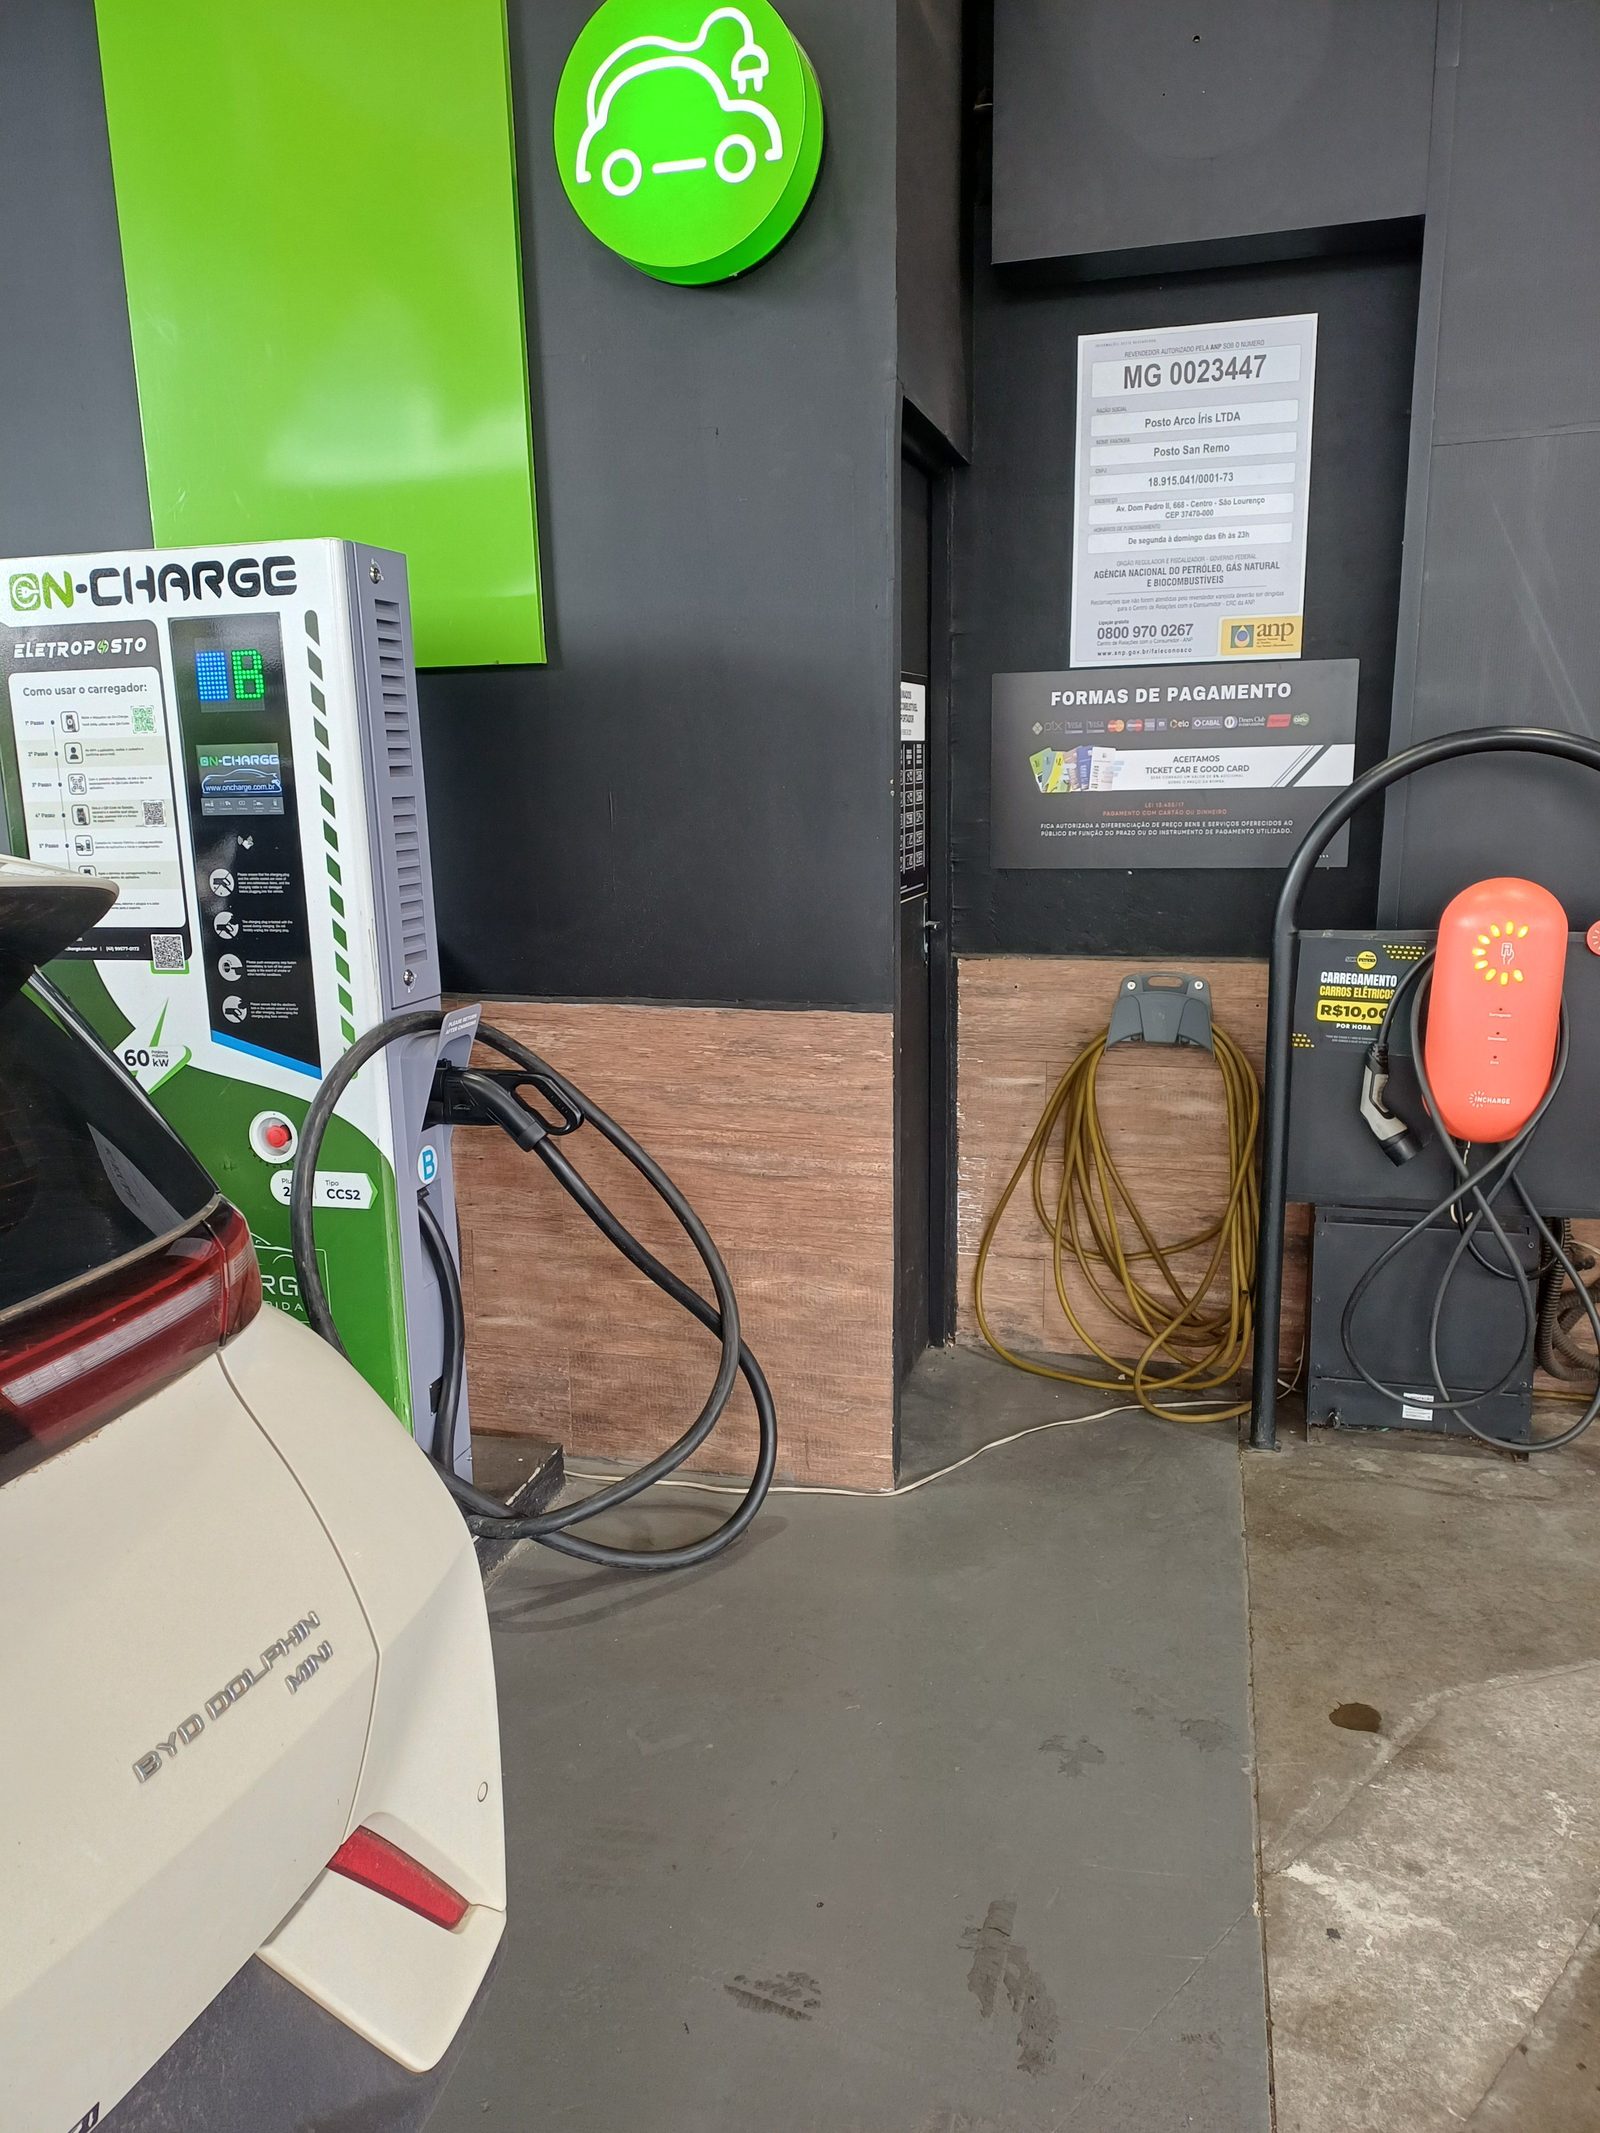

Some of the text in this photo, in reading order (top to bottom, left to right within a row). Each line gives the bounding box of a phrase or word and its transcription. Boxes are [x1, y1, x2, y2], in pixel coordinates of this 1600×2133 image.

[1124, 354, 1267, 389] MG 0023447
[1144, 411, 1241, 428] Posto Arco Íris LTDA
[1154, 444, 1230, 457] Posto San Remo
[1148, 472, 1234, 487] 18.915.041/0001-73
[1128, 504, 1144, 512] Dom
[1144, 503, 1164, 511] Pedro
[1190, 500, 1212, 508] Centro
[1233, 496, 1265, 506] Lourenço
[1165, 511, 1180, 519] CEP
[1138, 536, 1166, 546] segunda
[1174, 534, 1203, 543] domingo
[1204, 532, 1216, 540] das
[1094, 568, 1127, 579] AGÊNCIA
[1128, 567, 1167, 577] NACIONAL
[1169, 566, 1180, 575] DO
[1244, 562, 1280, 571] NATURAL
[8, 555, 297, 611] ON-CHARGE
[1147, 576, 1224, 587] E BIOCOMBUSTÍVEIS
[1097, 624, 1194, 640] 0800 970 0267
[1256, 622, 1294, 642] anp
[13, 637, 147, 661] ELETROPOSTO
[231, 648, 265, 700] B
[23, 683, 148, 697] Como usar o carregador:
[1051, 682, 1292, 706] FORMAS DE PAGAMENTO
[200, 754, 279, 766] ON-CHARGE
[1173, 755, 1220, 763] ACEITAMOS
[1145, 766, 1172, 774] TICKET
[1200, 765, 1224, 773] GOOD
[205, 784, 275, 793] www.oncharge.com.br
[1101, 821, 1150, 829] DIFERENCIAÇÃO
[1078, 829, 1103, 837] FUNÇÃO
[1320, 971, 1398, 987] CARREGAMENTO
[1319, 985, 1395, 1000] CARROS ELÉTRICOS
[124, 1049, 169, 1067] 60 kW
[1474, 1096, 1510, 1104] INCHARGE
[422, 1150, 435, 1180] B
[326, 1189, 361, 1200] CCS2
[285, 1640, 334, 1695] MINI
[132, 1610, 320, 1784] BYD DOLPHIN
